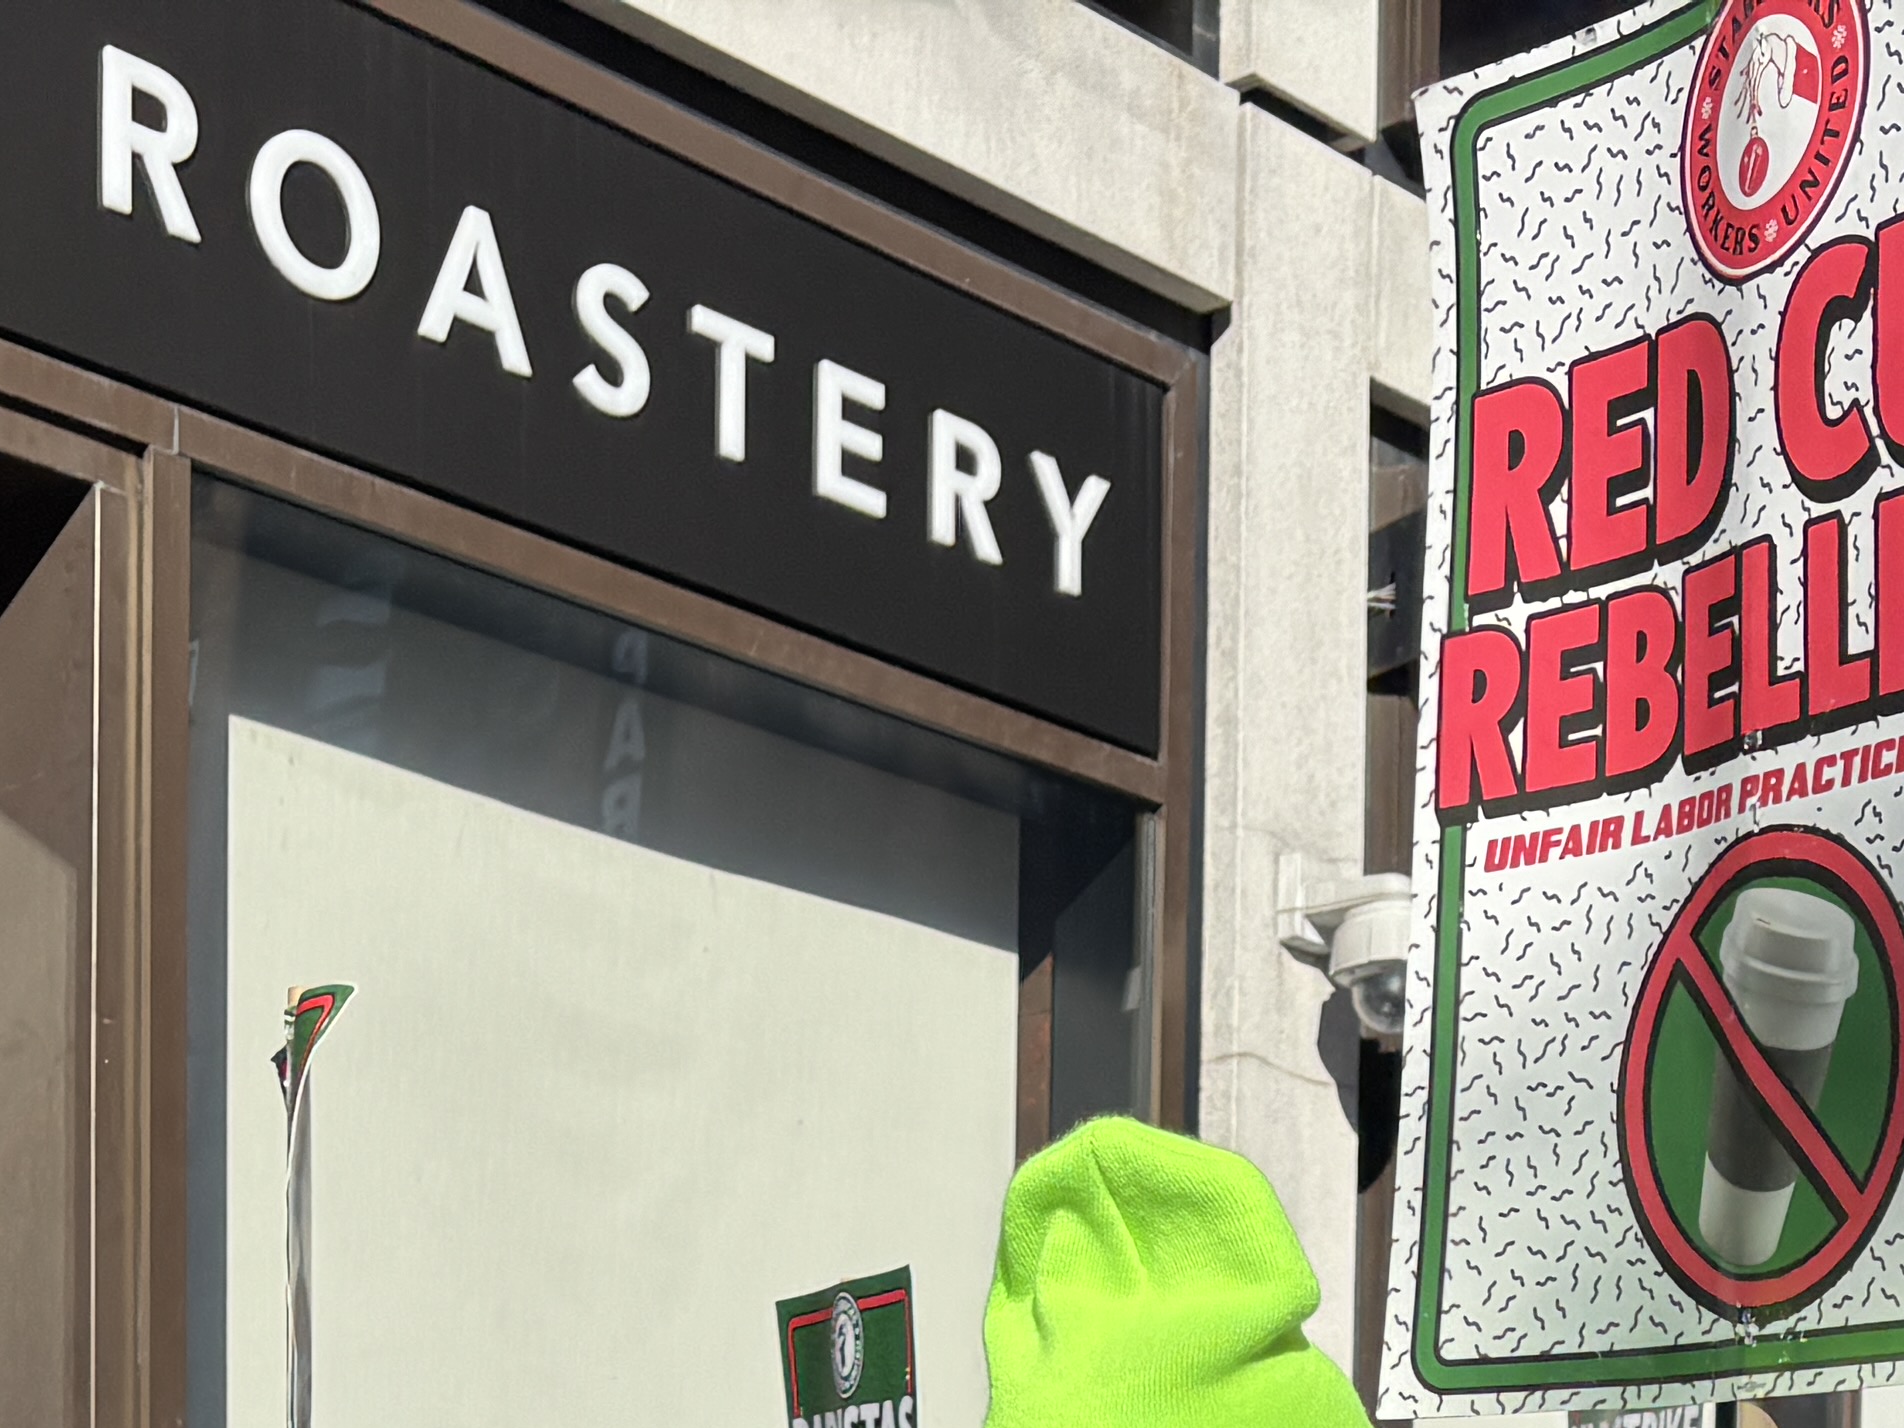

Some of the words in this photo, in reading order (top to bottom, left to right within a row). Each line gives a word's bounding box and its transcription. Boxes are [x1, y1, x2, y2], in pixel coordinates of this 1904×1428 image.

[1697, 123, 1761, 256] WORKERS
[1781, 54, 1849, 227] UNITED
[101, 43, 1112, 598] ROASTERY
[1467, 316, 1736, 600] RED
[1484, 818, 1622, 874] UNFAIR
[1630, 786, 1733, 848] LABOR
